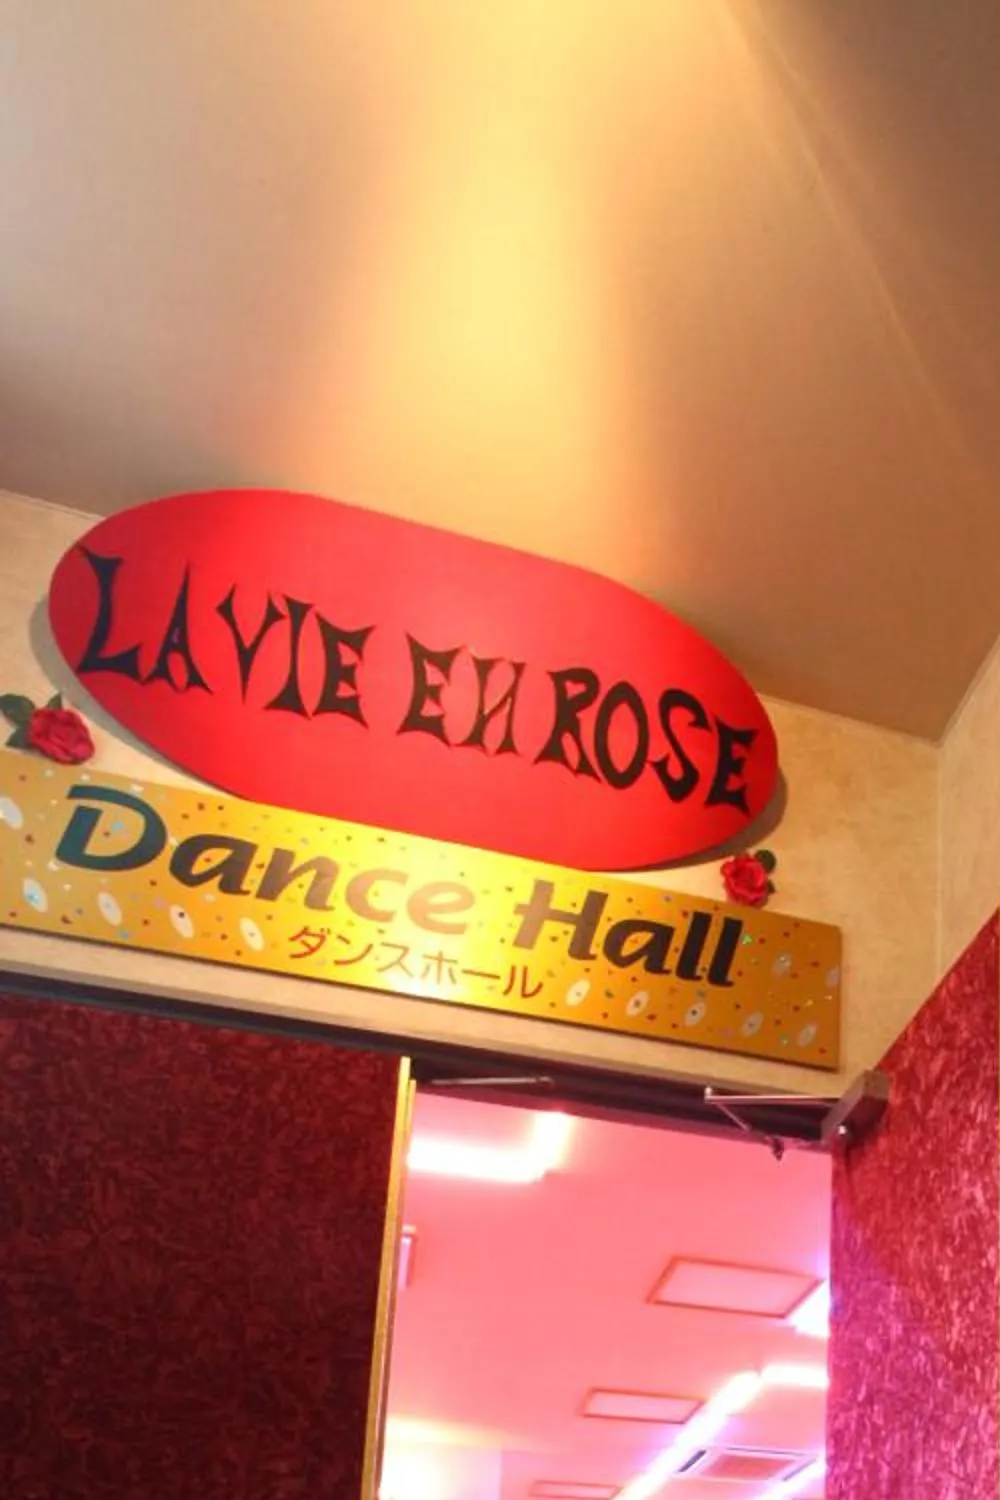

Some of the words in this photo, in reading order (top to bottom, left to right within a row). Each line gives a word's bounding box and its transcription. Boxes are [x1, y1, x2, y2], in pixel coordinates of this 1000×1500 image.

[533, 666, 760, 817] ROSE
[54, 785, 477, 935] Dance
[514, 878, 744, 988] Hall
[287, 924, 544, 1001] ダンスホール
